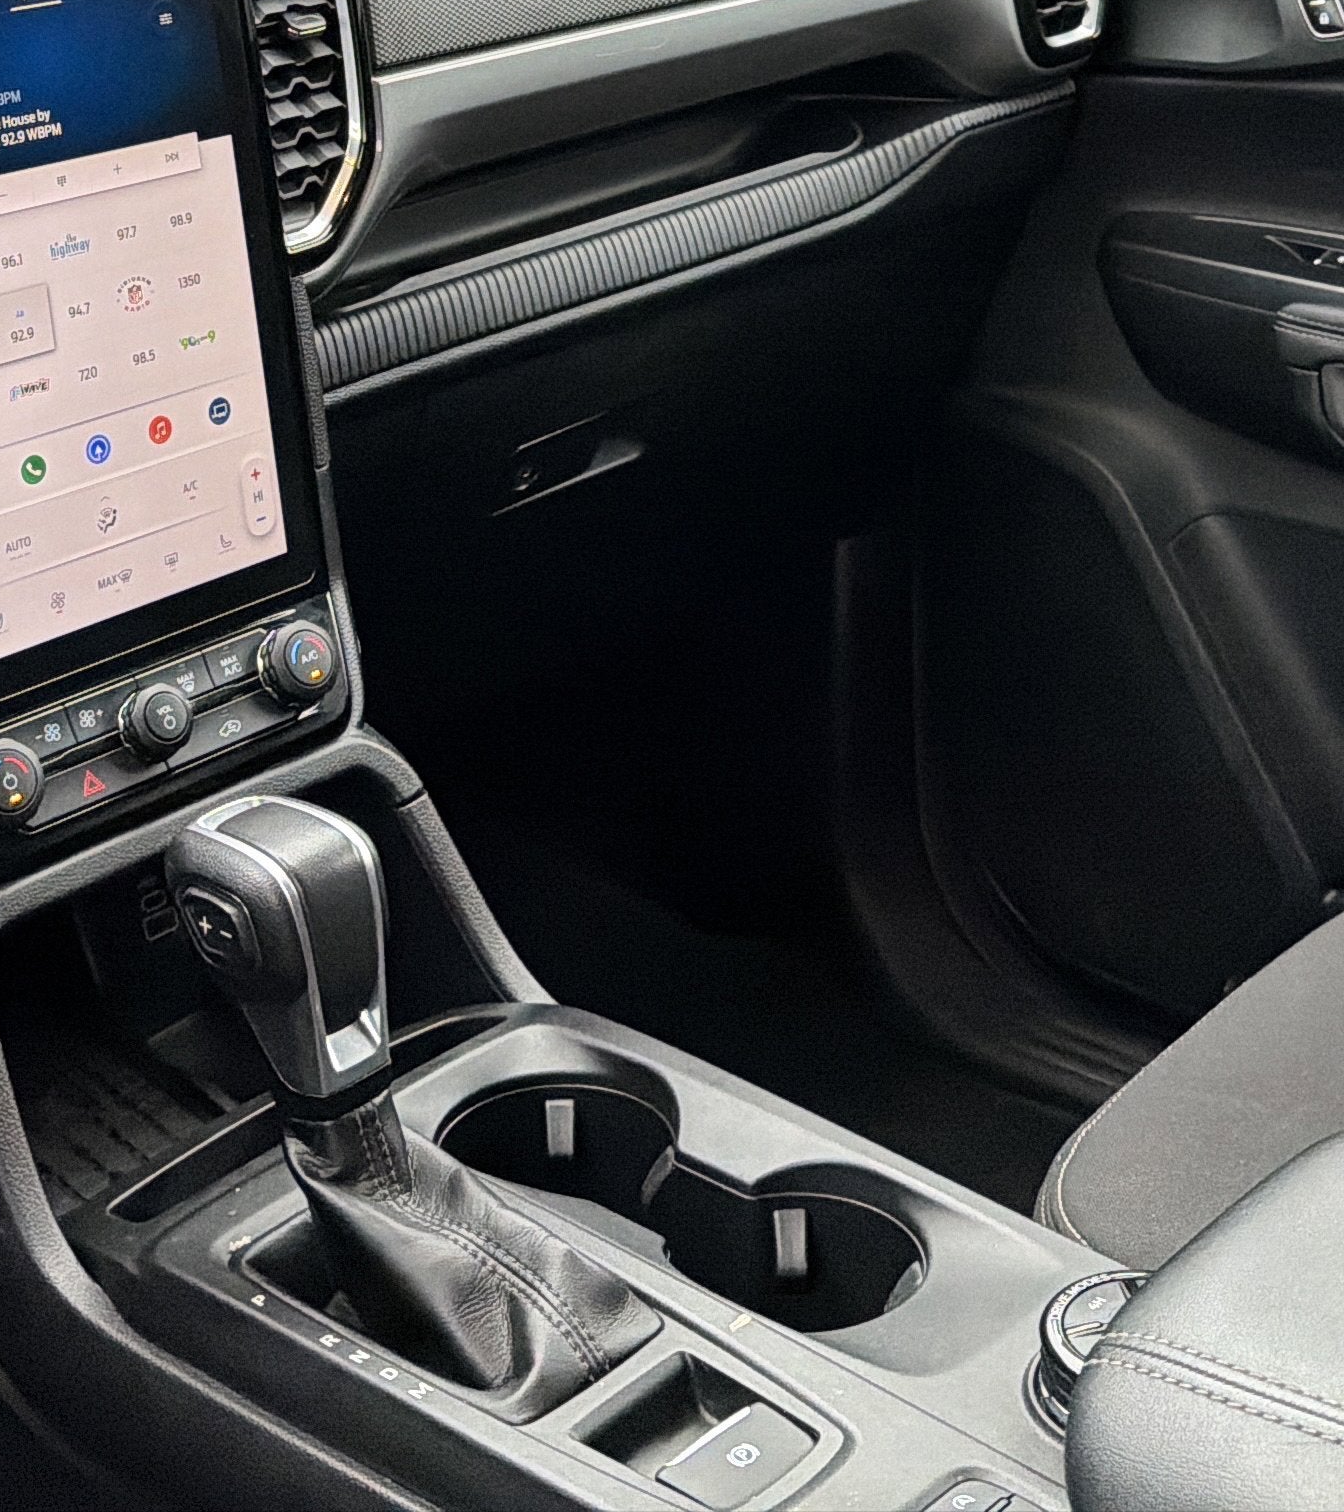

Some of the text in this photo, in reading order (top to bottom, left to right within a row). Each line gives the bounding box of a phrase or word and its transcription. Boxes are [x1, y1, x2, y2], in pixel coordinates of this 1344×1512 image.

[2, 113, 36, 129] House
[37, 109, 51, 123] by
[1, 131, 25, 147] 92.9
[26, 123, 63, 142] WBPM
[169, 212, 193, 228] 98.9
[116, 225, 138, 241] 97.7
[49, 239, 91, 258] highway
[1, 253, 24, 269] 96.1
[178, 273, 201, 289] 1350
[68, 302, 91, 318] 94.7
[10, 327, 35, 343] 92.9
[132, 348, 156, 366] 98.5
[78, 366, 98, 382] 720
[182, 480, 198, 494] A/C
[252, 491, 264, 504] HI
[5, 536, 32, 554] AUTO
[97, 574, 118, 591] MAX
[220, 655, 239, 668] MAX
[301, 650, 319, 665] A/C
[176, 671, 195, 685] MAX
[223, 663, 243, 677] A/C
[156, 704, 174, 716] VOL
[250, 1294, 266, 1307] P
[319, 1334, 341, 1348] R
[348, 1349, 371, 1364] N
[379, 1367, 399, 1381] D
[408, 1381, 435, 1400] M
